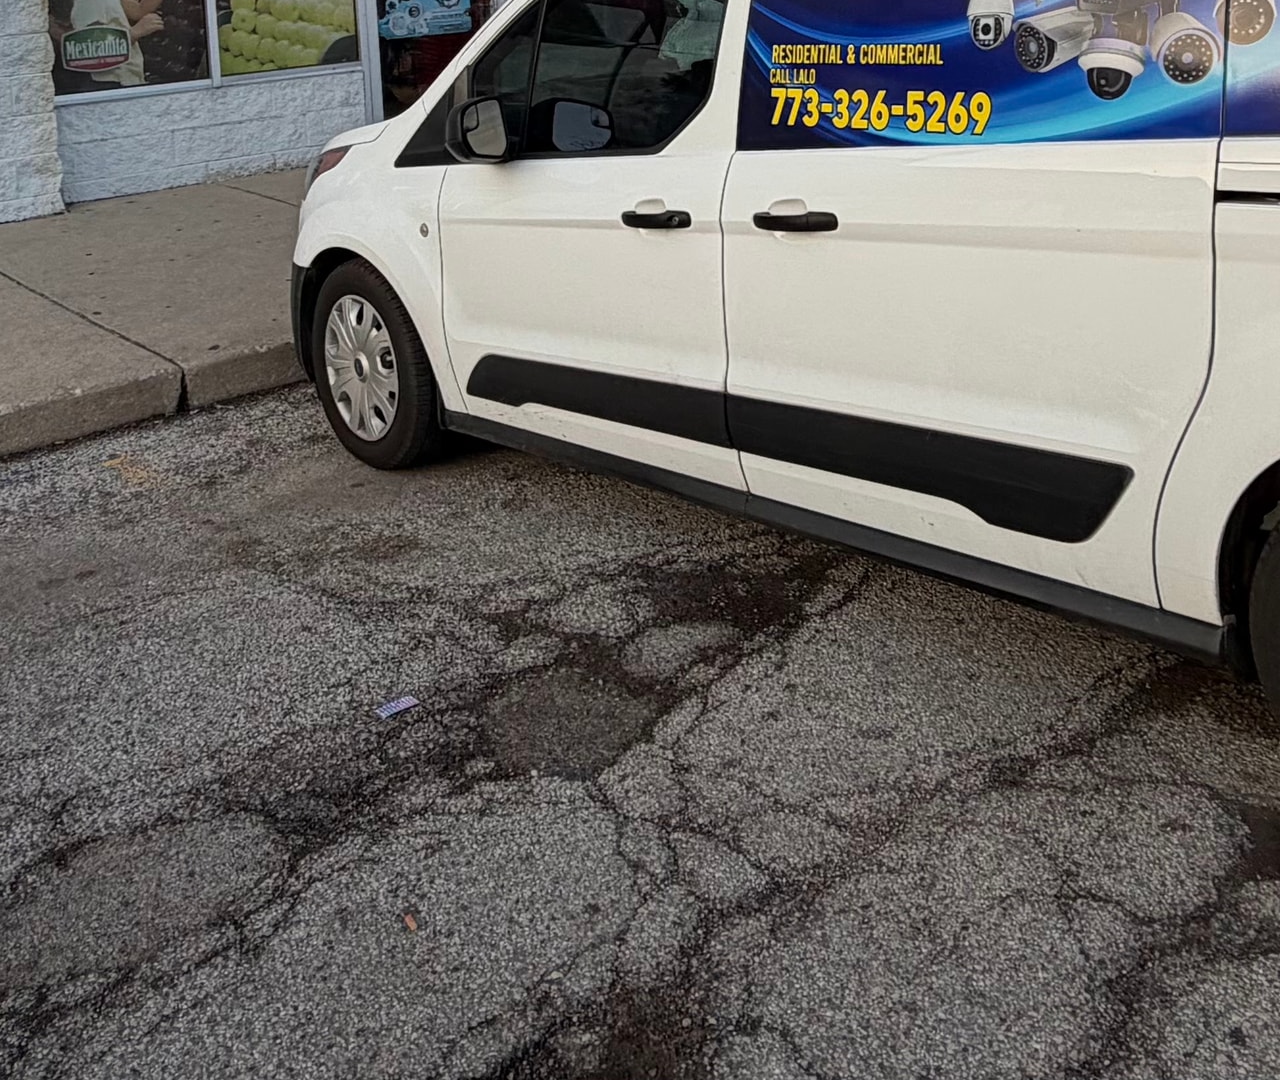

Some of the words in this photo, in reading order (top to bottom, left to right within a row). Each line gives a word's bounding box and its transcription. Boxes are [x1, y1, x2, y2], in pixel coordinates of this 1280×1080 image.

[65, 36, 128, 60] Mexicanita
[772, 44, 843, 65] RESIDENTIAL
[847, 44, 856, 64] &
[859, 44, 944, 65] COMMERCIAL
[770, 68, 790, 84] CALL
[793, 68, 816, 84] LALO
[770, 87, 992, 136] 773-326-5269
